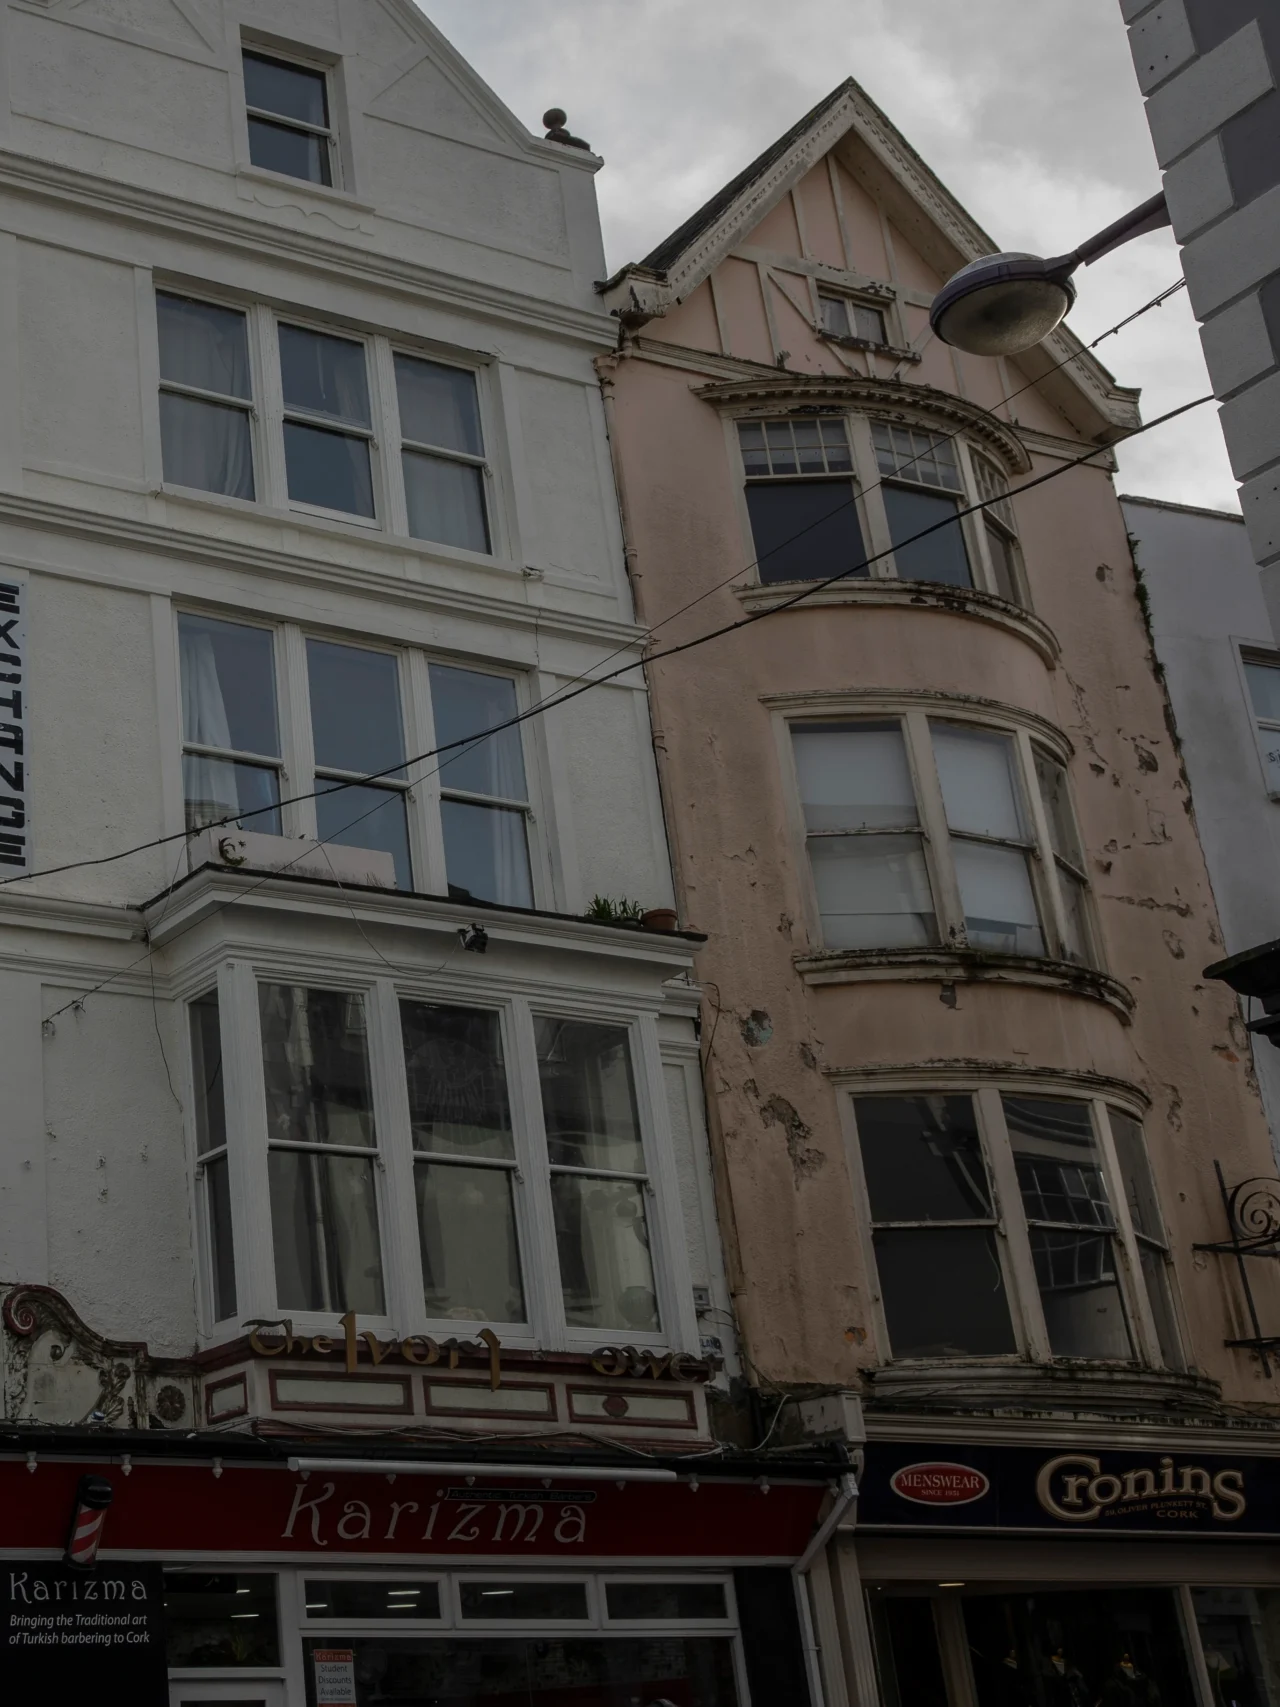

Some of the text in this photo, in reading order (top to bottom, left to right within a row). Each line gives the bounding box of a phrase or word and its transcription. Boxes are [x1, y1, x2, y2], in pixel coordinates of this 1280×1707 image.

[242, 1319, 334, 1356] The
[901, 1474, 980, 1488] MENSWEAR
[1035, 1453, 1247, 1522] Cronins
[280, 1482, 587, 1546] Karizma
[1117, 1504, 1148, 1514] OLIVER
[1151, 1501, 1194, 1509] PLUNKETT
[1156, 1510, 1200, 1518] CORK
[9, 1572, 148, 1604] Karizma
[10, 1614, 147, 1629] Bringing the Traditional art
[9, 1631, 150, 1647] of Turkish barbering to Cork
[321, 1664, 348, 1672] Student
[318, 1676, 352, 1684] Discounts
